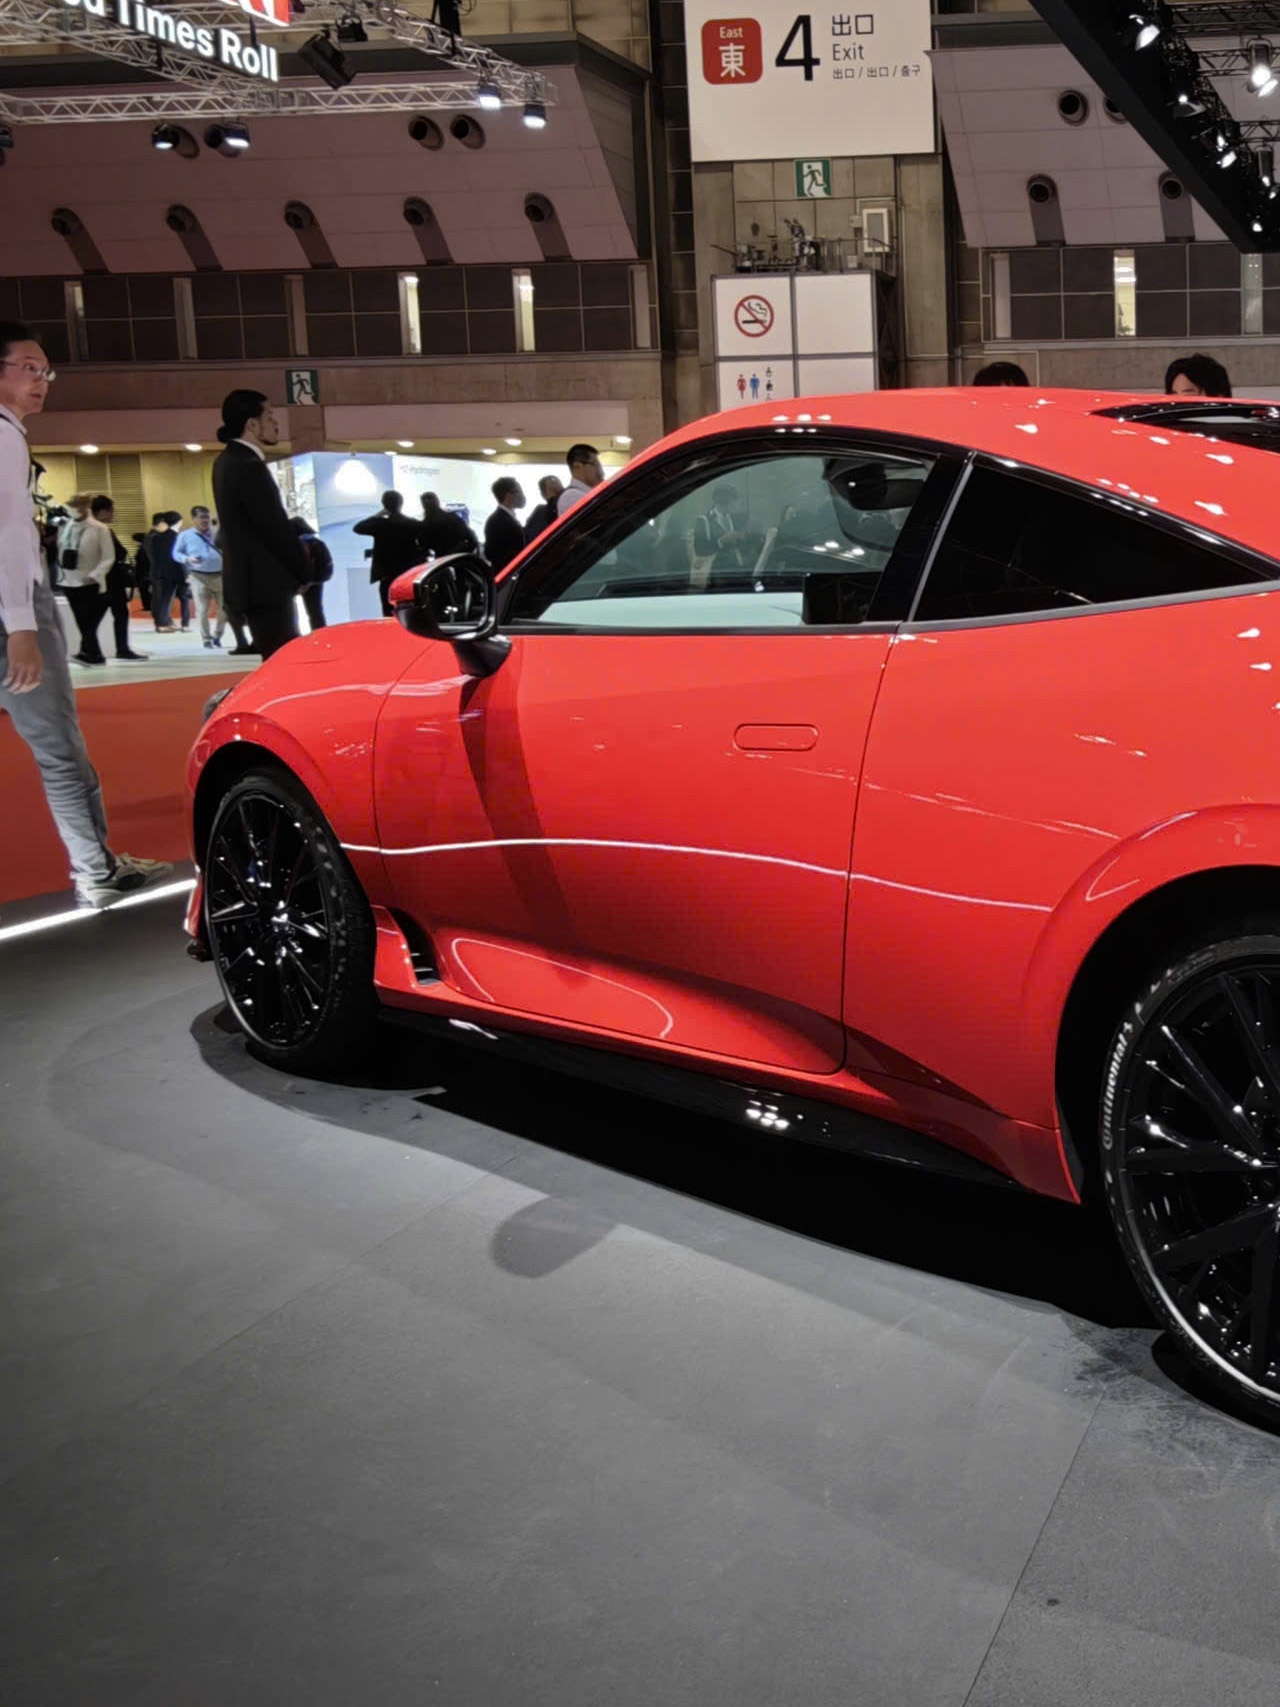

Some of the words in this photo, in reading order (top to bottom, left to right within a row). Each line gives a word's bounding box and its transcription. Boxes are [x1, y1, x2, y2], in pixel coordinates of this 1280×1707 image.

[115, 0, 214, 57] Times
[219, 28, 279, 82] Roll
[719, 26, 744, 39] East
[831, 14, 874, 36] 出口
[718, 42, 747, 78] 東
[775, 14, 820, 81] 4
[832, 43, 865, 61] Exit
[1102, 1033, 1128, 1150] Continental
